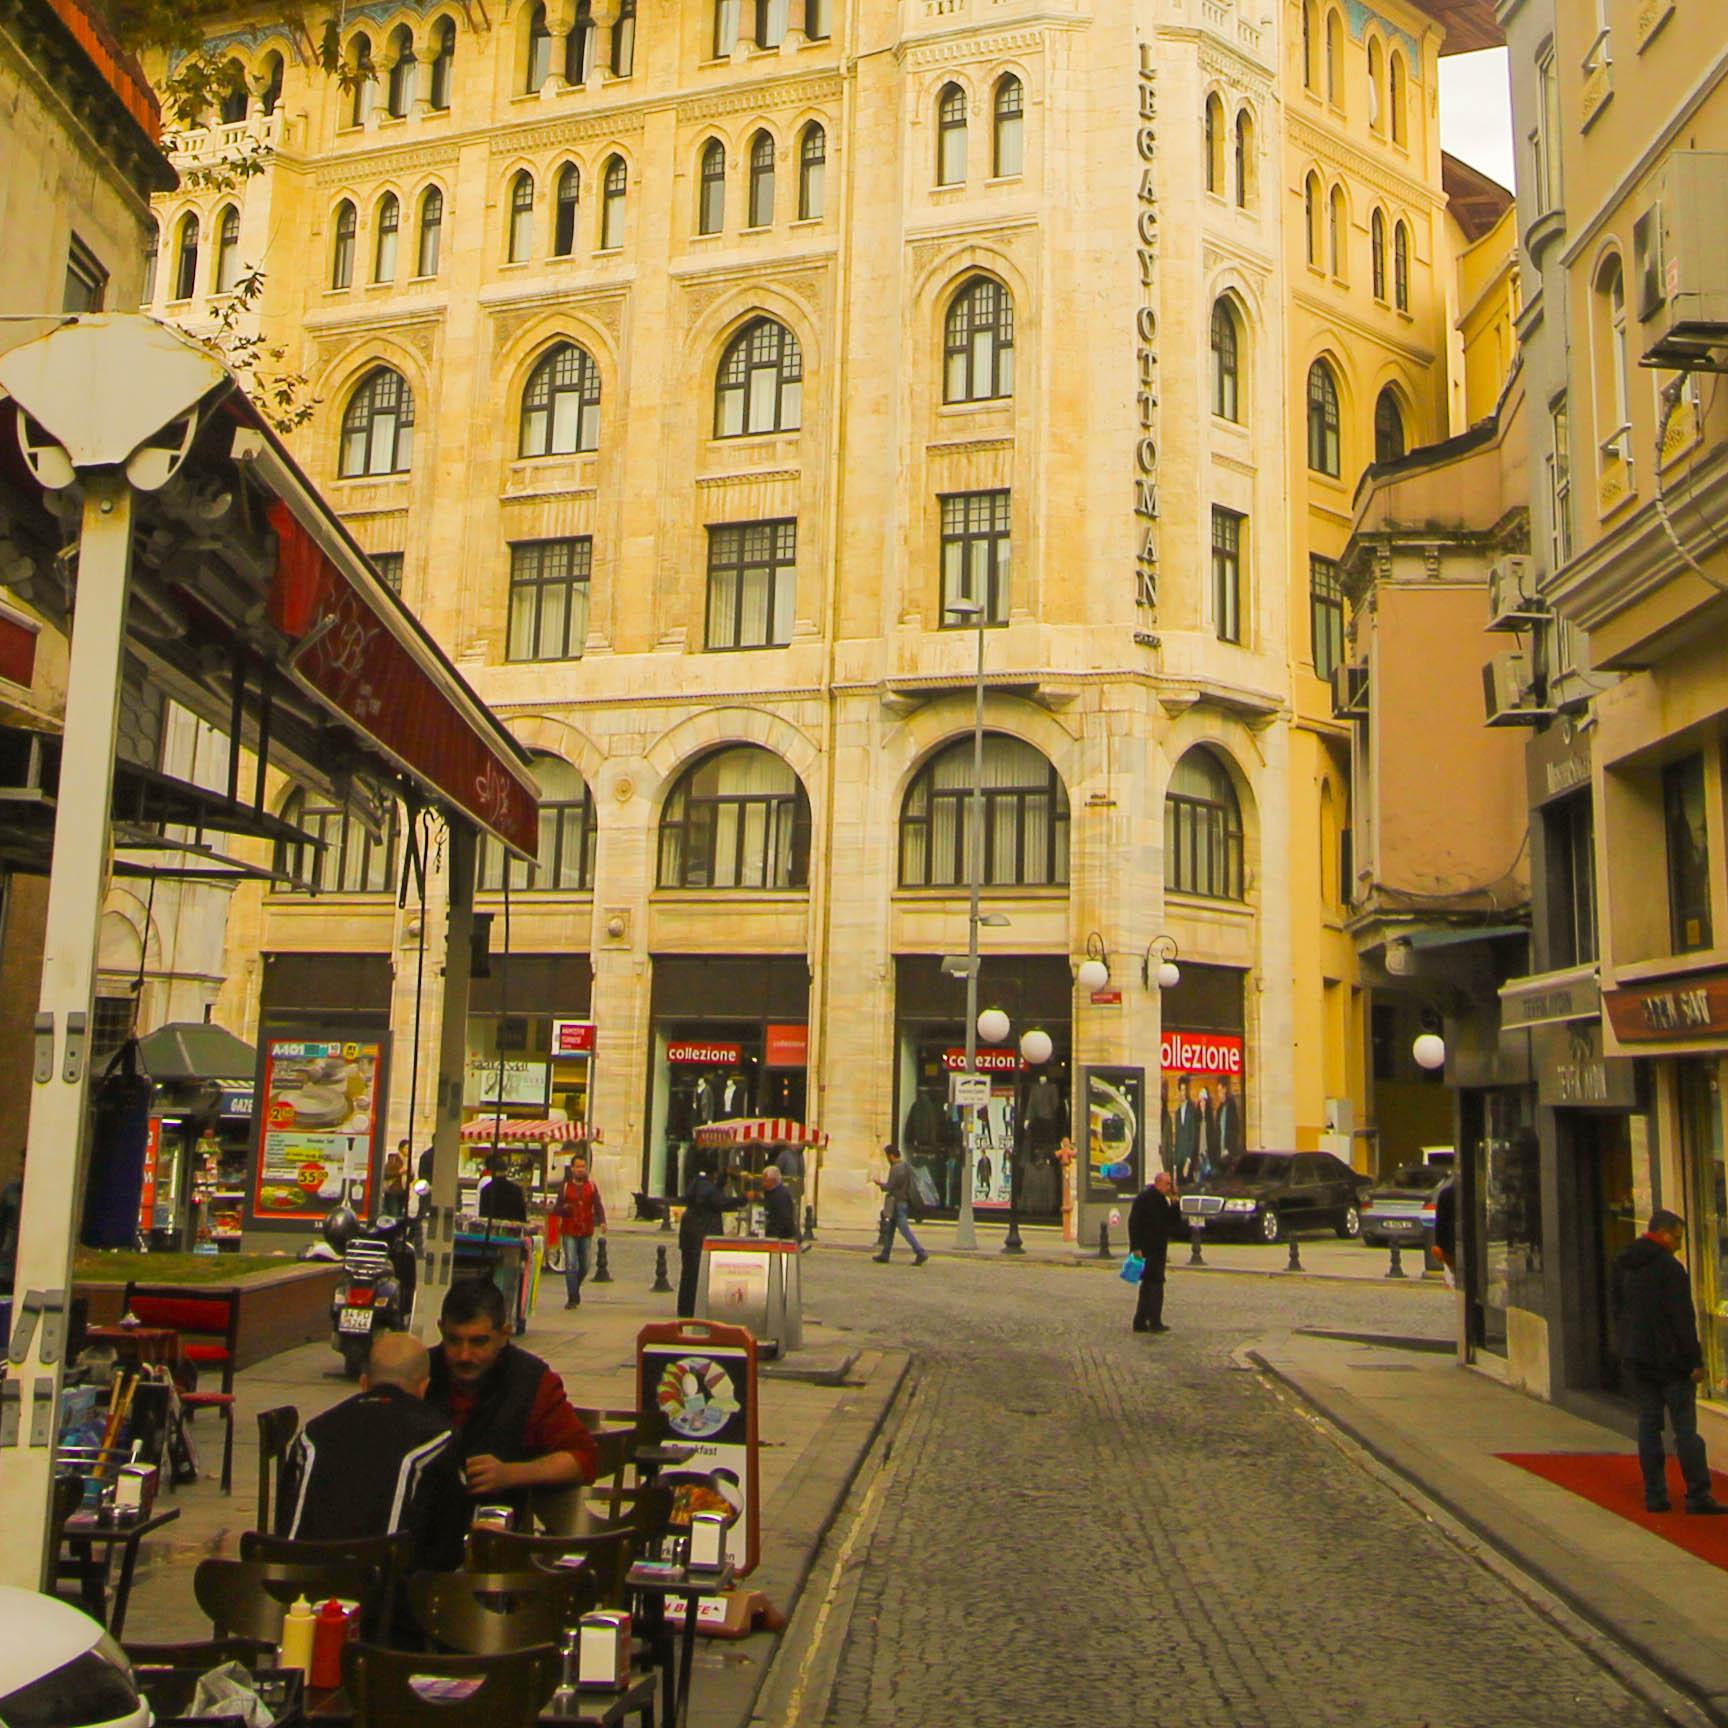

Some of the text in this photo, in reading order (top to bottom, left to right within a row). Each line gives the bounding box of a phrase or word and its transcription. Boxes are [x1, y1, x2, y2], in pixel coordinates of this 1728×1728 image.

[1135, 41, 1159, 287] LEGACY
[1135, 305, 1160, 608] OTTOMAN
[668, 1046, 738, 1062] collezione
[948, 1052, 1025, 1069] coezione
[1160, 1034, 1241, 1072] ollezione
